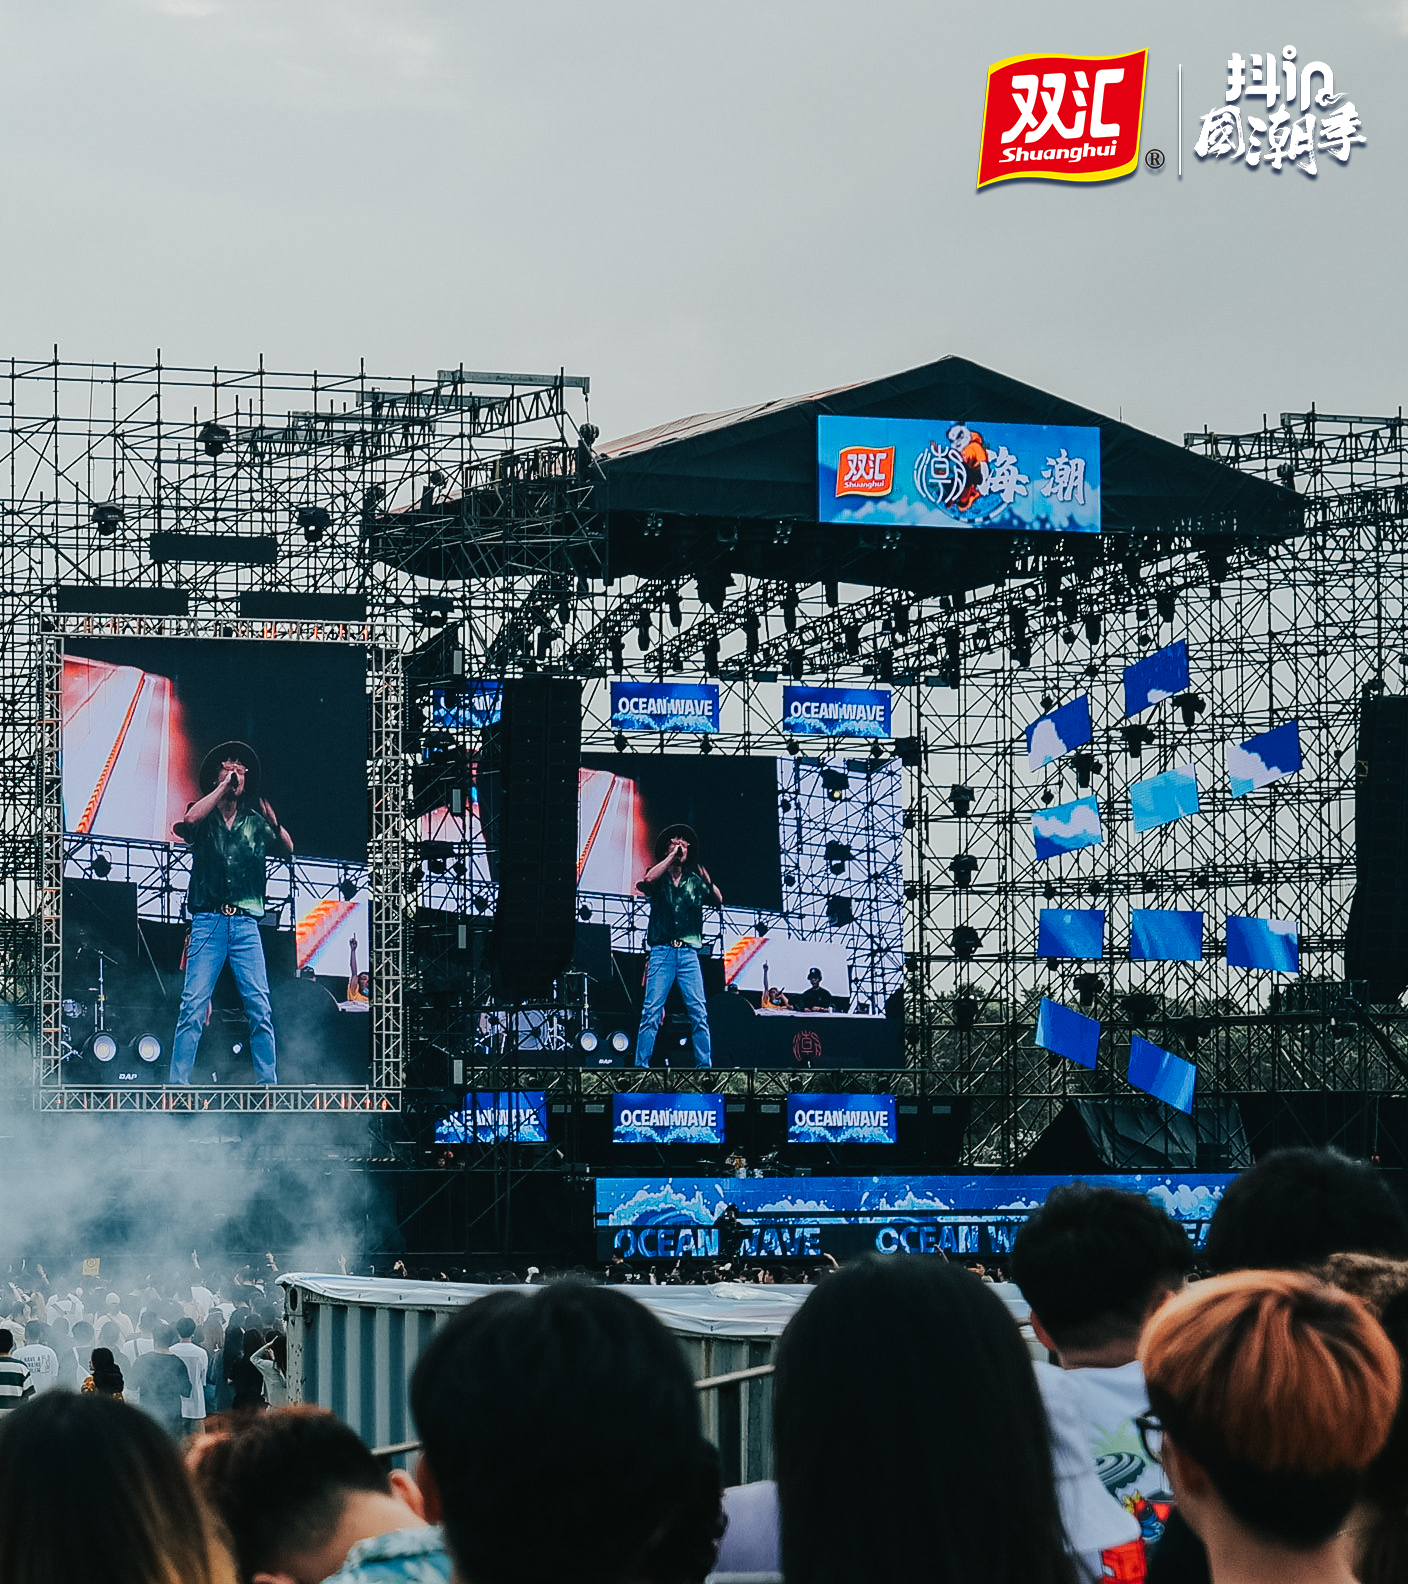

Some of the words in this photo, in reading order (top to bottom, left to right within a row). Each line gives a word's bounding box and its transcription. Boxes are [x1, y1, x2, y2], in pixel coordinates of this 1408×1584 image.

[843, 452, 887, 481] 双汇
[843, 480, 885, 490] Shuanghui
[618, 697, 667, 715] OCEAN
[671, 699, 713, 716] WAVE
[790, 701, 839, 719] OCEAN
[842, 703, 885, 721] WAVE
[620, 1109, 670, 1126] OCEAN
[672, 1110, 717, 1127] WAVE
[794, 1109, 842, 1127] OCEAN
[844, 1110, 889, 1127] WAVE
[614, 1228, 719, 1257] OCEAN
[876, 1225, 979, 1255] OCEAN
